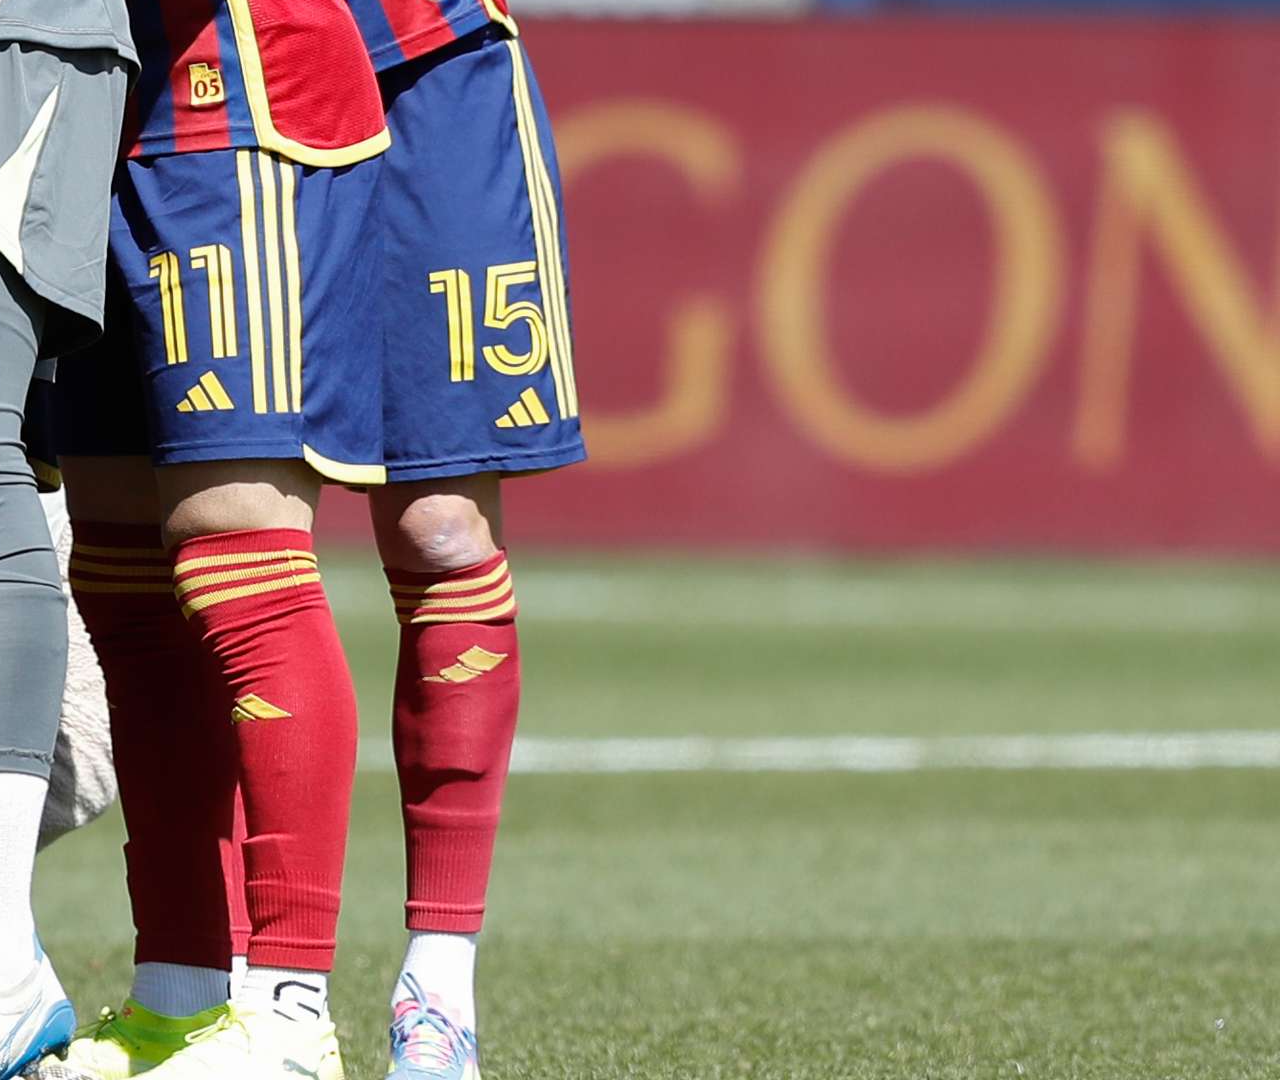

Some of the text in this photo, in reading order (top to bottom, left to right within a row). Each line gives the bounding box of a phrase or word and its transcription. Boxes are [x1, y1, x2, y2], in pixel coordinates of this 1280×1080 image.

[194, 78, 221, 98] 05
[148, 244, 238, 365] 11
[428, 260, 548, 383] 15
